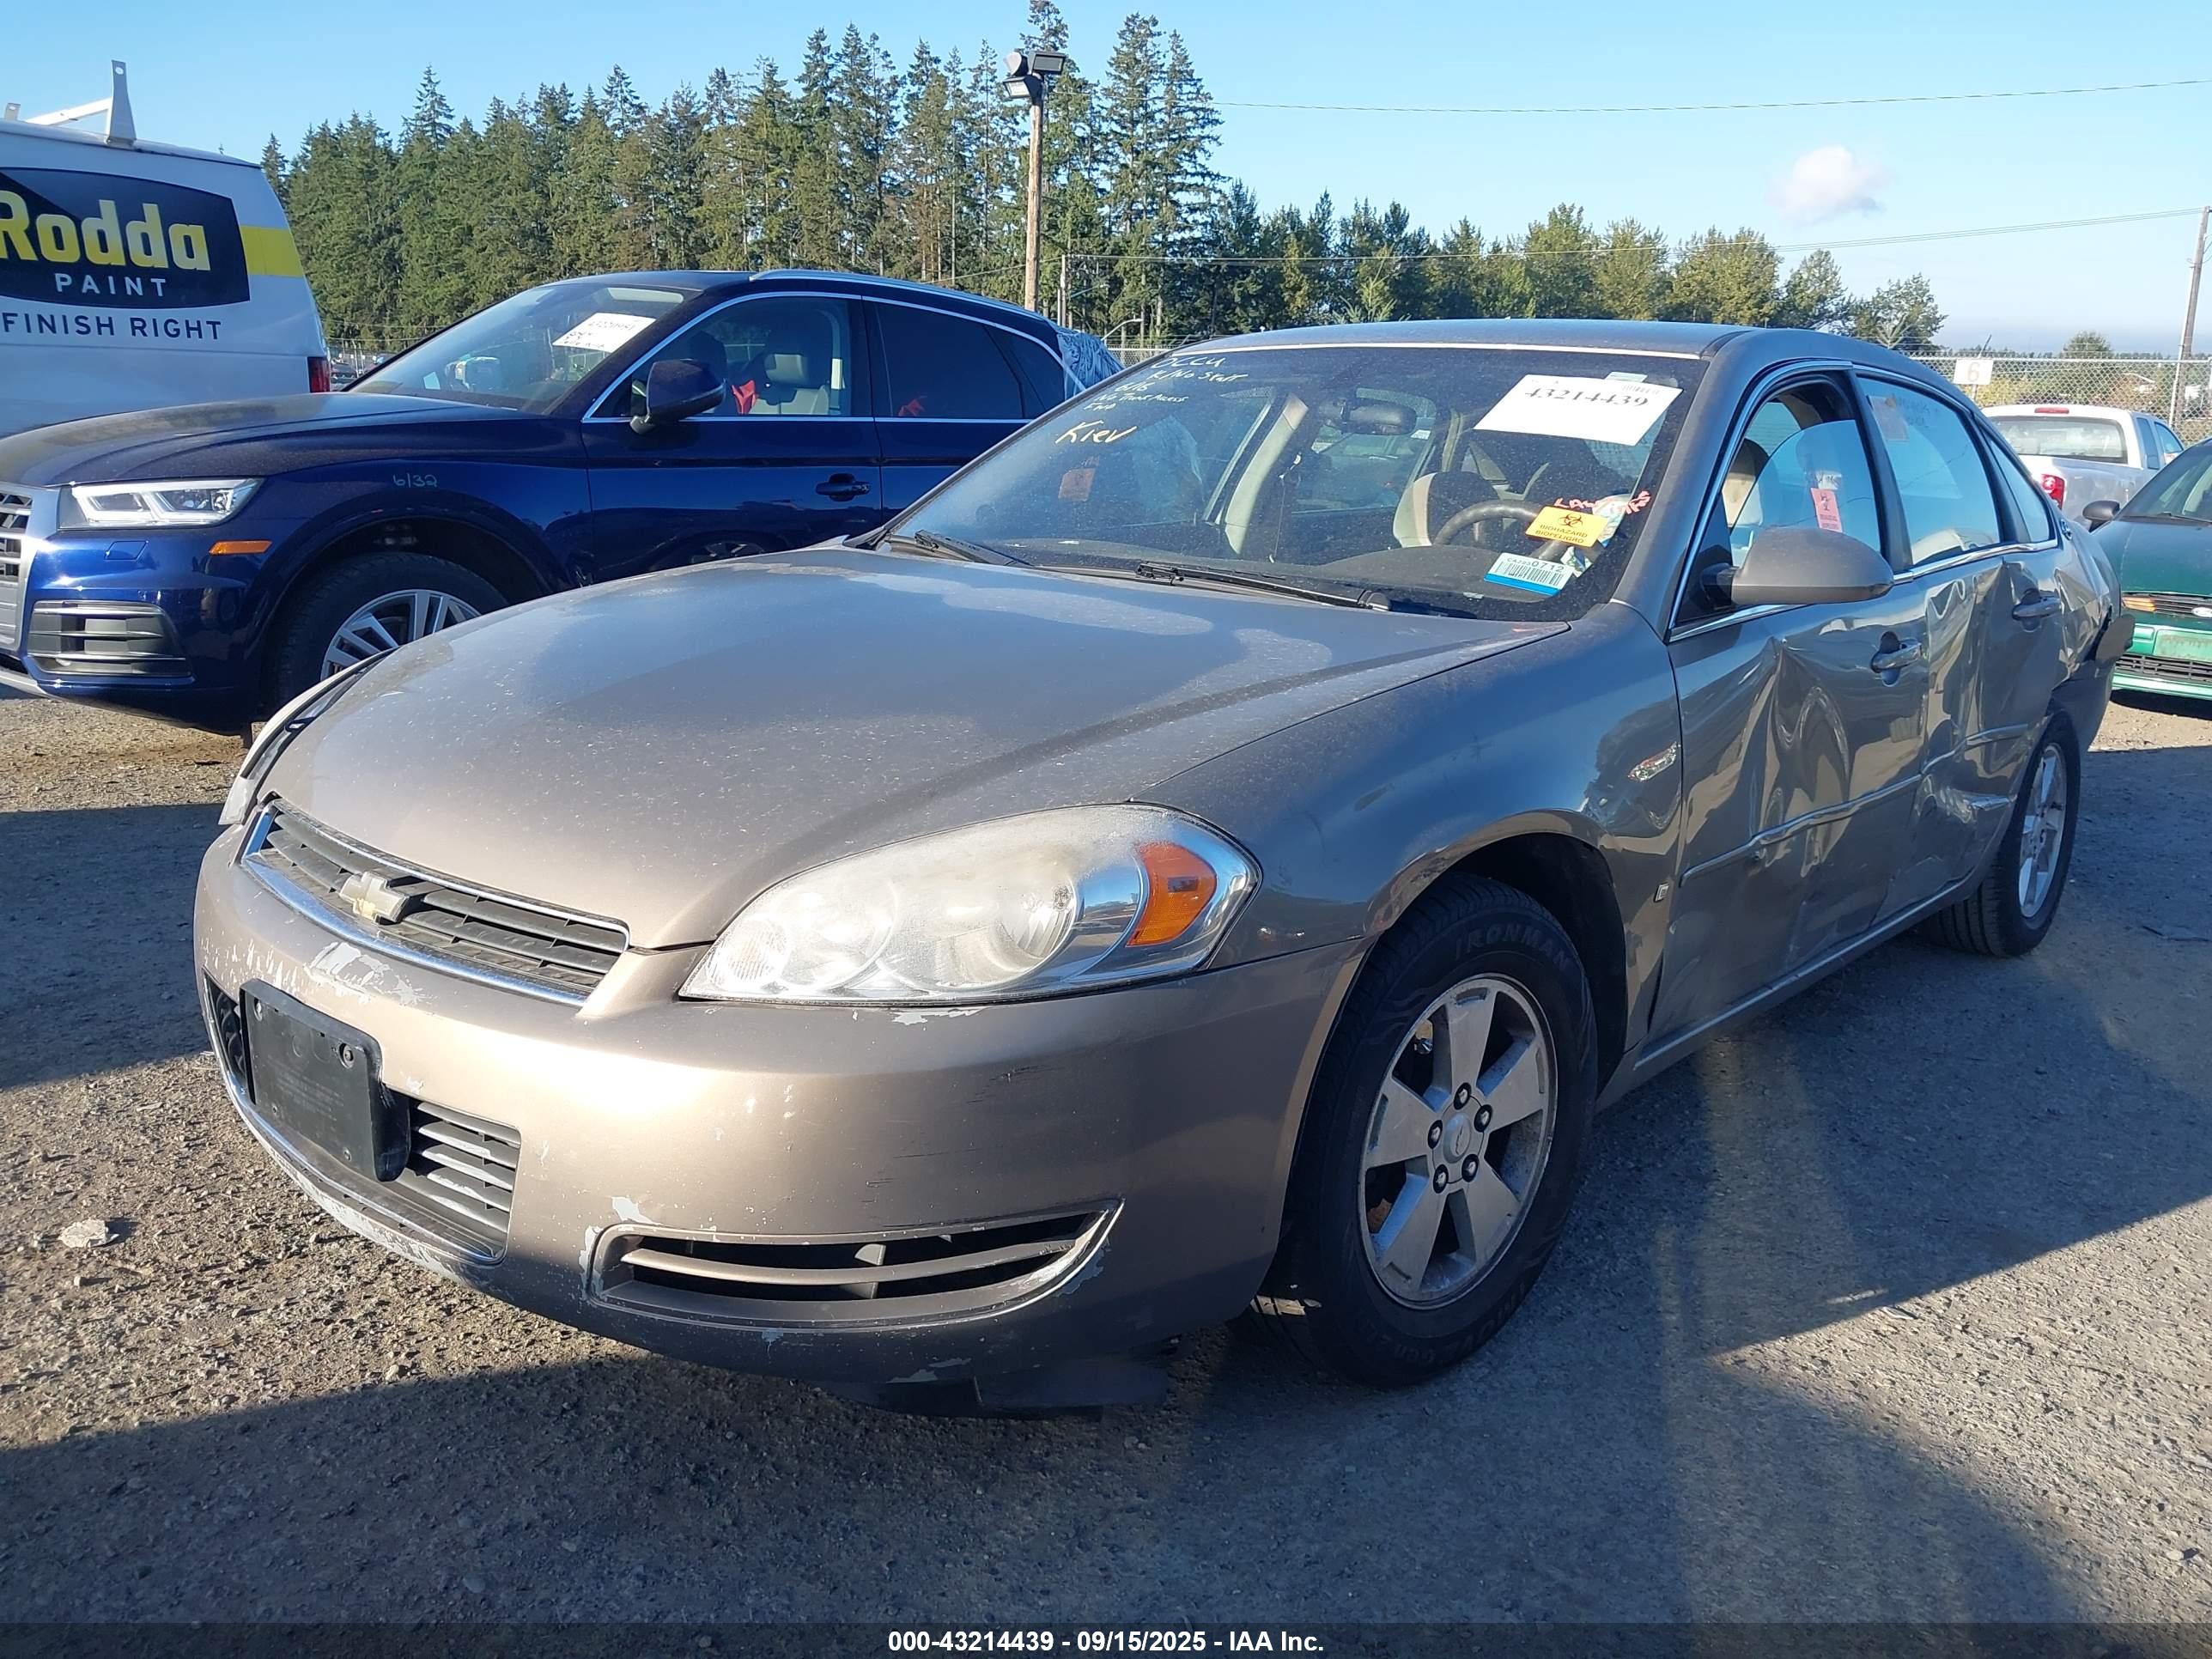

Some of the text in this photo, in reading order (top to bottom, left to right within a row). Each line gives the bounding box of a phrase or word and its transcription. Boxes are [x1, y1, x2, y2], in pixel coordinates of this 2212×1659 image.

[0, 191, 211, 271] Rodda
[54, 273, 167, 297] PAINT
[2, 312, 222, 340] FINISH RIGHT
[1524, 387, 1650, 407] 43214439
[1535, 530, 1584, 544] BIOPELIGRO
[1540, 524, 1588, 538] BIOHAZARD
